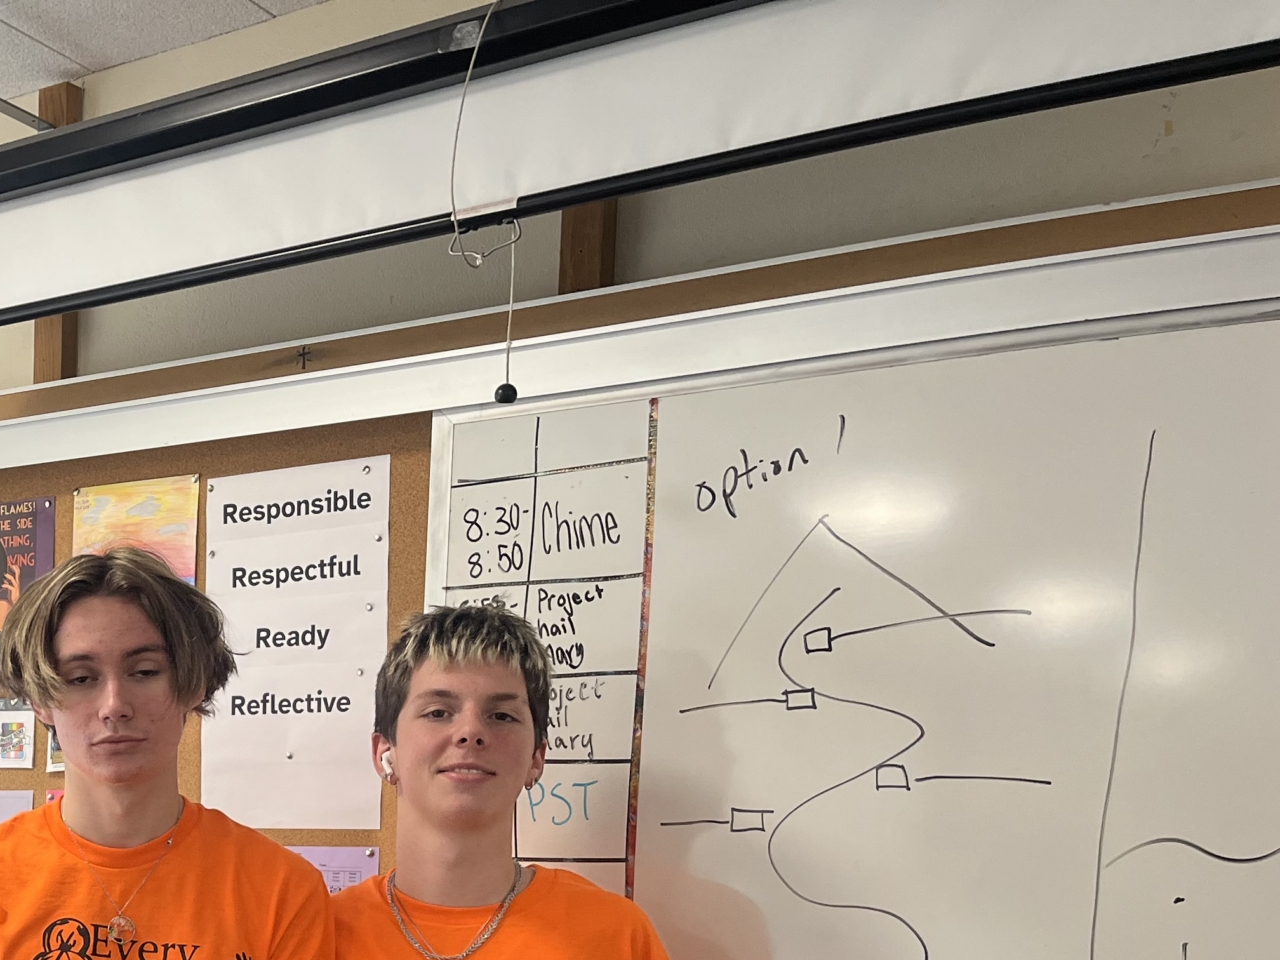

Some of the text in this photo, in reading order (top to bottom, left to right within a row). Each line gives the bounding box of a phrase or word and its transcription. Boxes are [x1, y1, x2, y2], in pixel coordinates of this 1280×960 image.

[695, 448, 809, 519] option
[17, 517, 33, 529] SIDE
[223, 489, 371, 524] Responsible
[542, 501, 620, 554] Chime
[232, 554, 361, 588] Respectful
[467, 540, 524, 578] 8:50
[538, 584, 604, 617] Project
[256, 624, 330, 649] Ready
[538, 617, 576, 639] hail
[231, 690, 351, 715] Reflective
[527, 780, 599, 826] PST
